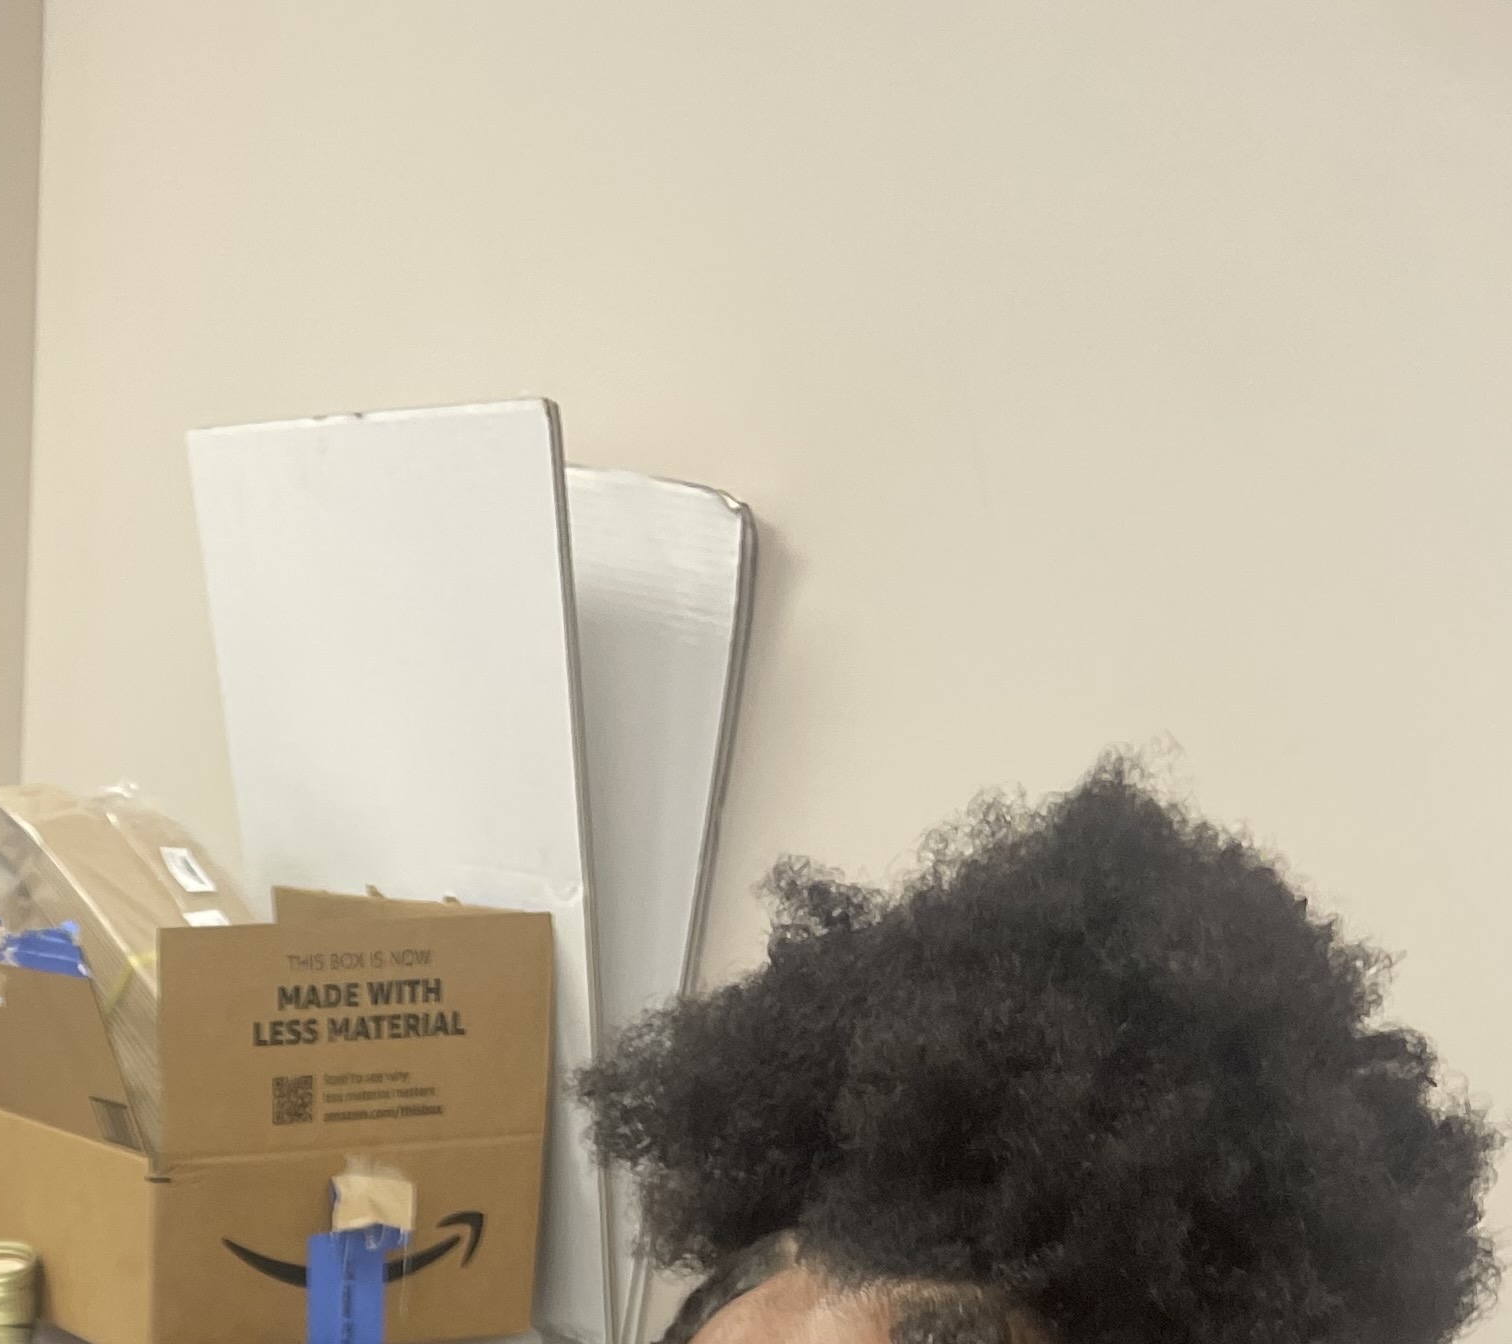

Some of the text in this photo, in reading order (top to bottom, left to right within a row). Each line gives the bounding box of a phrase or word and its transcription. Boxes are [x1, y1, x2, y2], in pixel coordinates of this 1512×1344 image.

[287, 949, 431, 971] THIS BOX IS NOW
[277, 978, 442, 1011] MADE WITH
[252, 1011, 467, 1047] LESS MATERIAL
